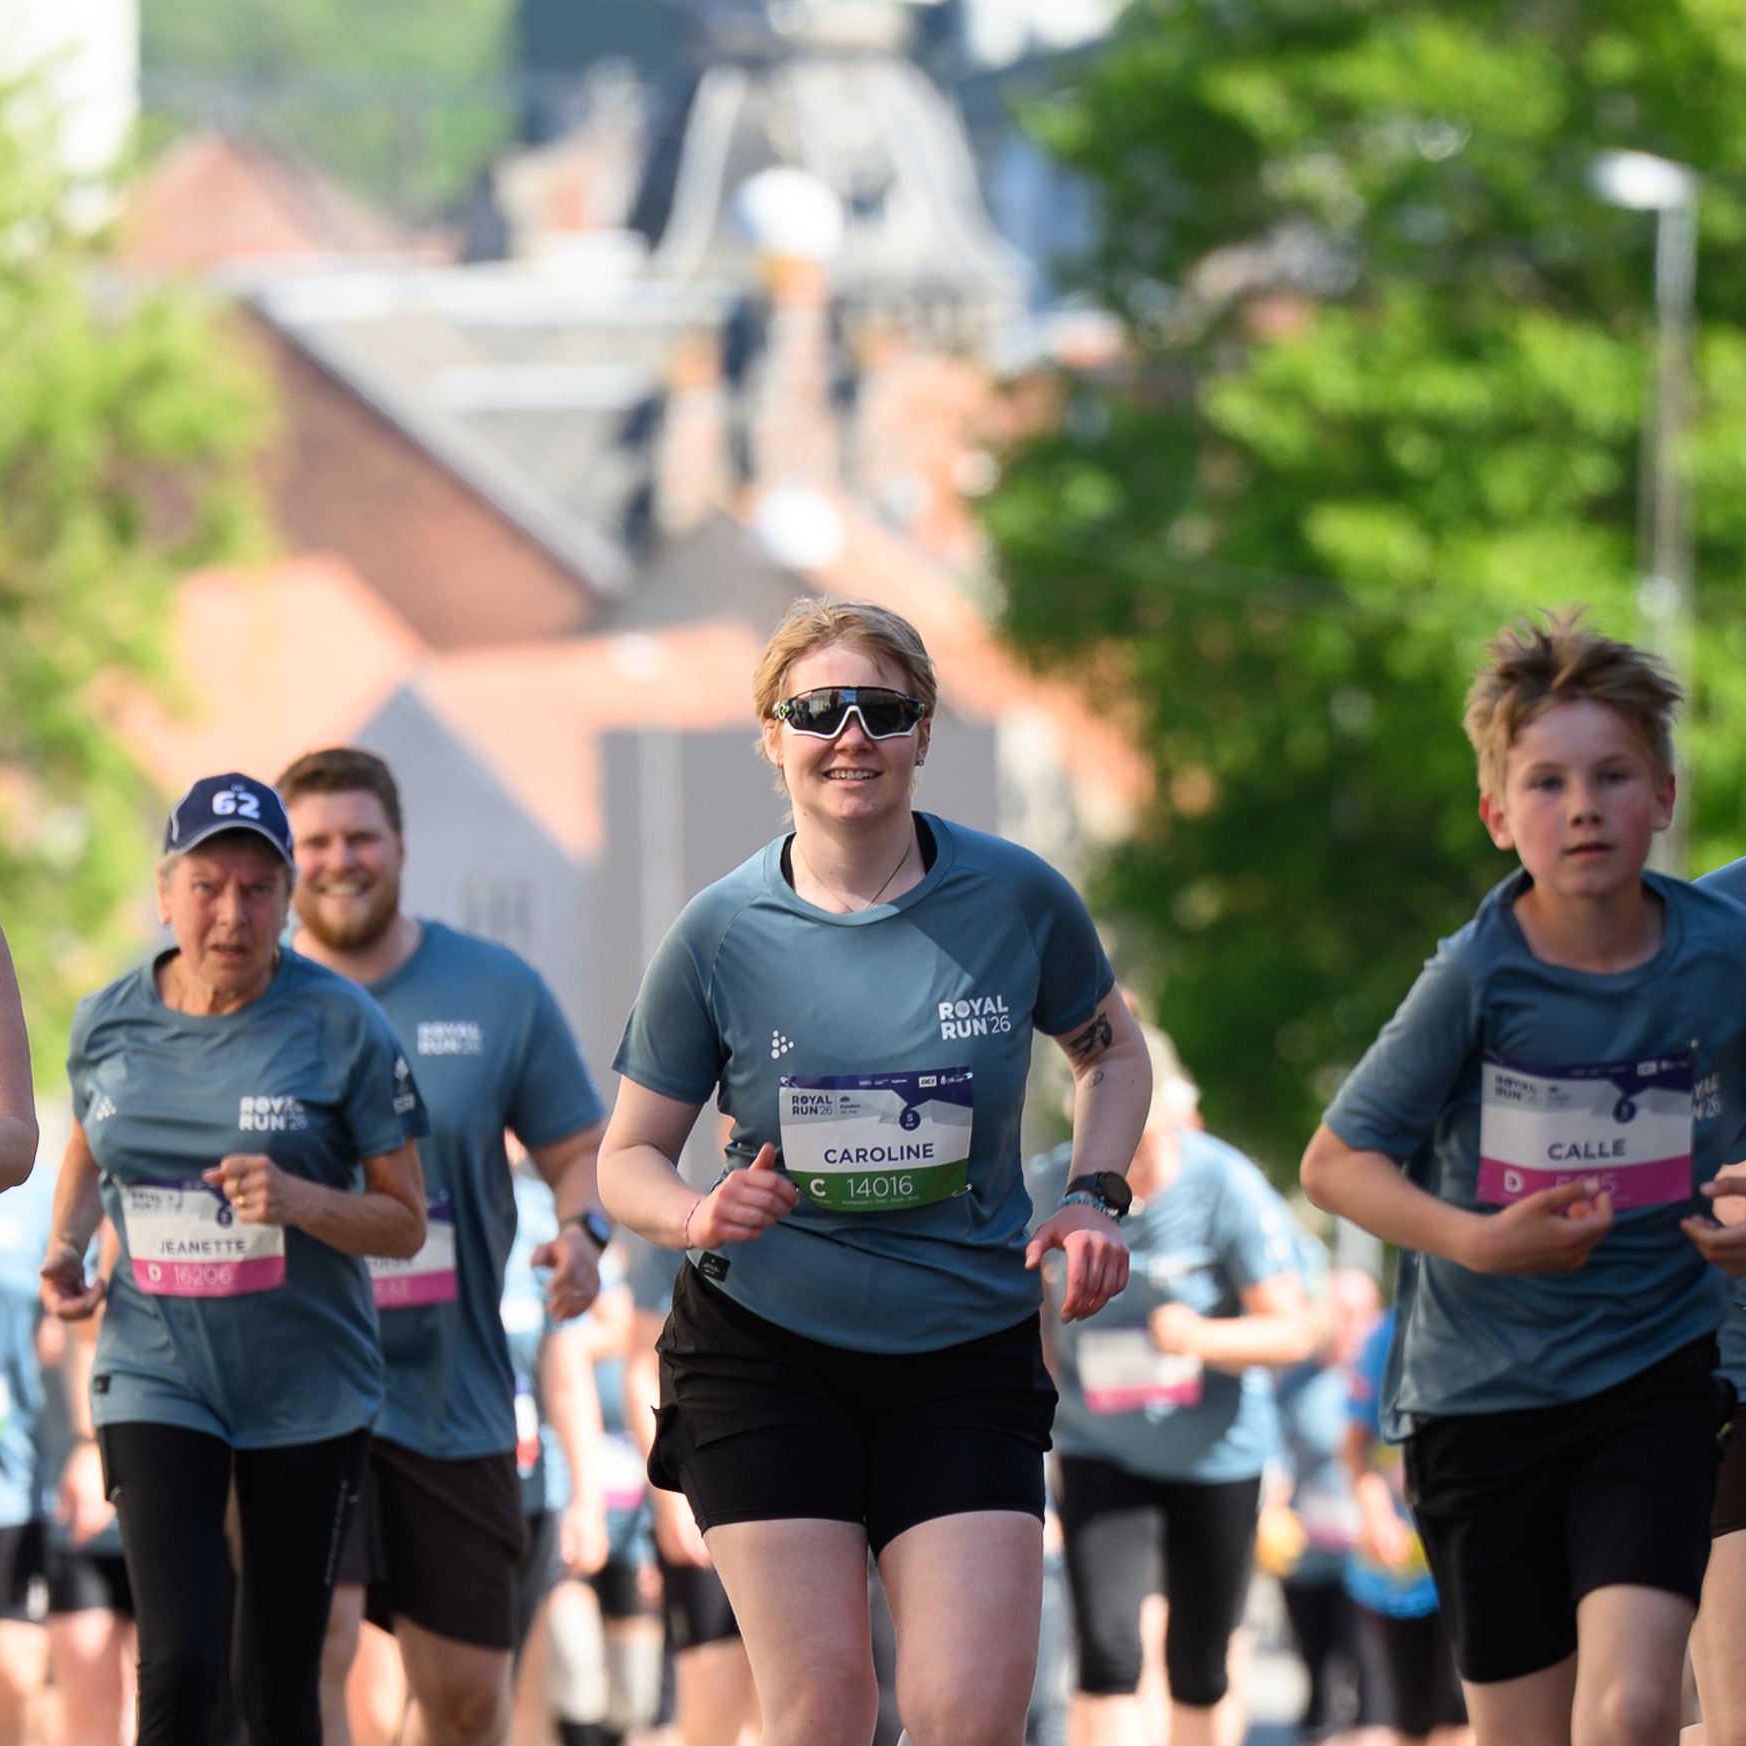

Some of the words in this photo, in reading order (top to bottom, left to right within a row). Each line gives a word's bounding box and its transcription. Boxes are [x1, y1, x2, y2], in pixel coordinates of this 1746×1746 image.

[212, 790, 260, 820] 62
[938, 994, 1009, 1020] ROYAL
[941, 1015, 1011, 1040] RUN'26
[1694, 1072, 1722, 1100] YAL
[792, 1095, 833, 1105] ROYAL
[907, 1113, 913, 1122] 5
[824, 1143, 935, 1164] CAROLINE
[1547, 1138, 1626, 1161] CALLE
[810, 1178, 826, 1197] C
[846, 1175, 913, 1198] 14016
[1504, 1169, 1525, 1193] D
[160, 1240, 246, 1255] JEANETTE
[174, 1265, 233, 1285] 16206
